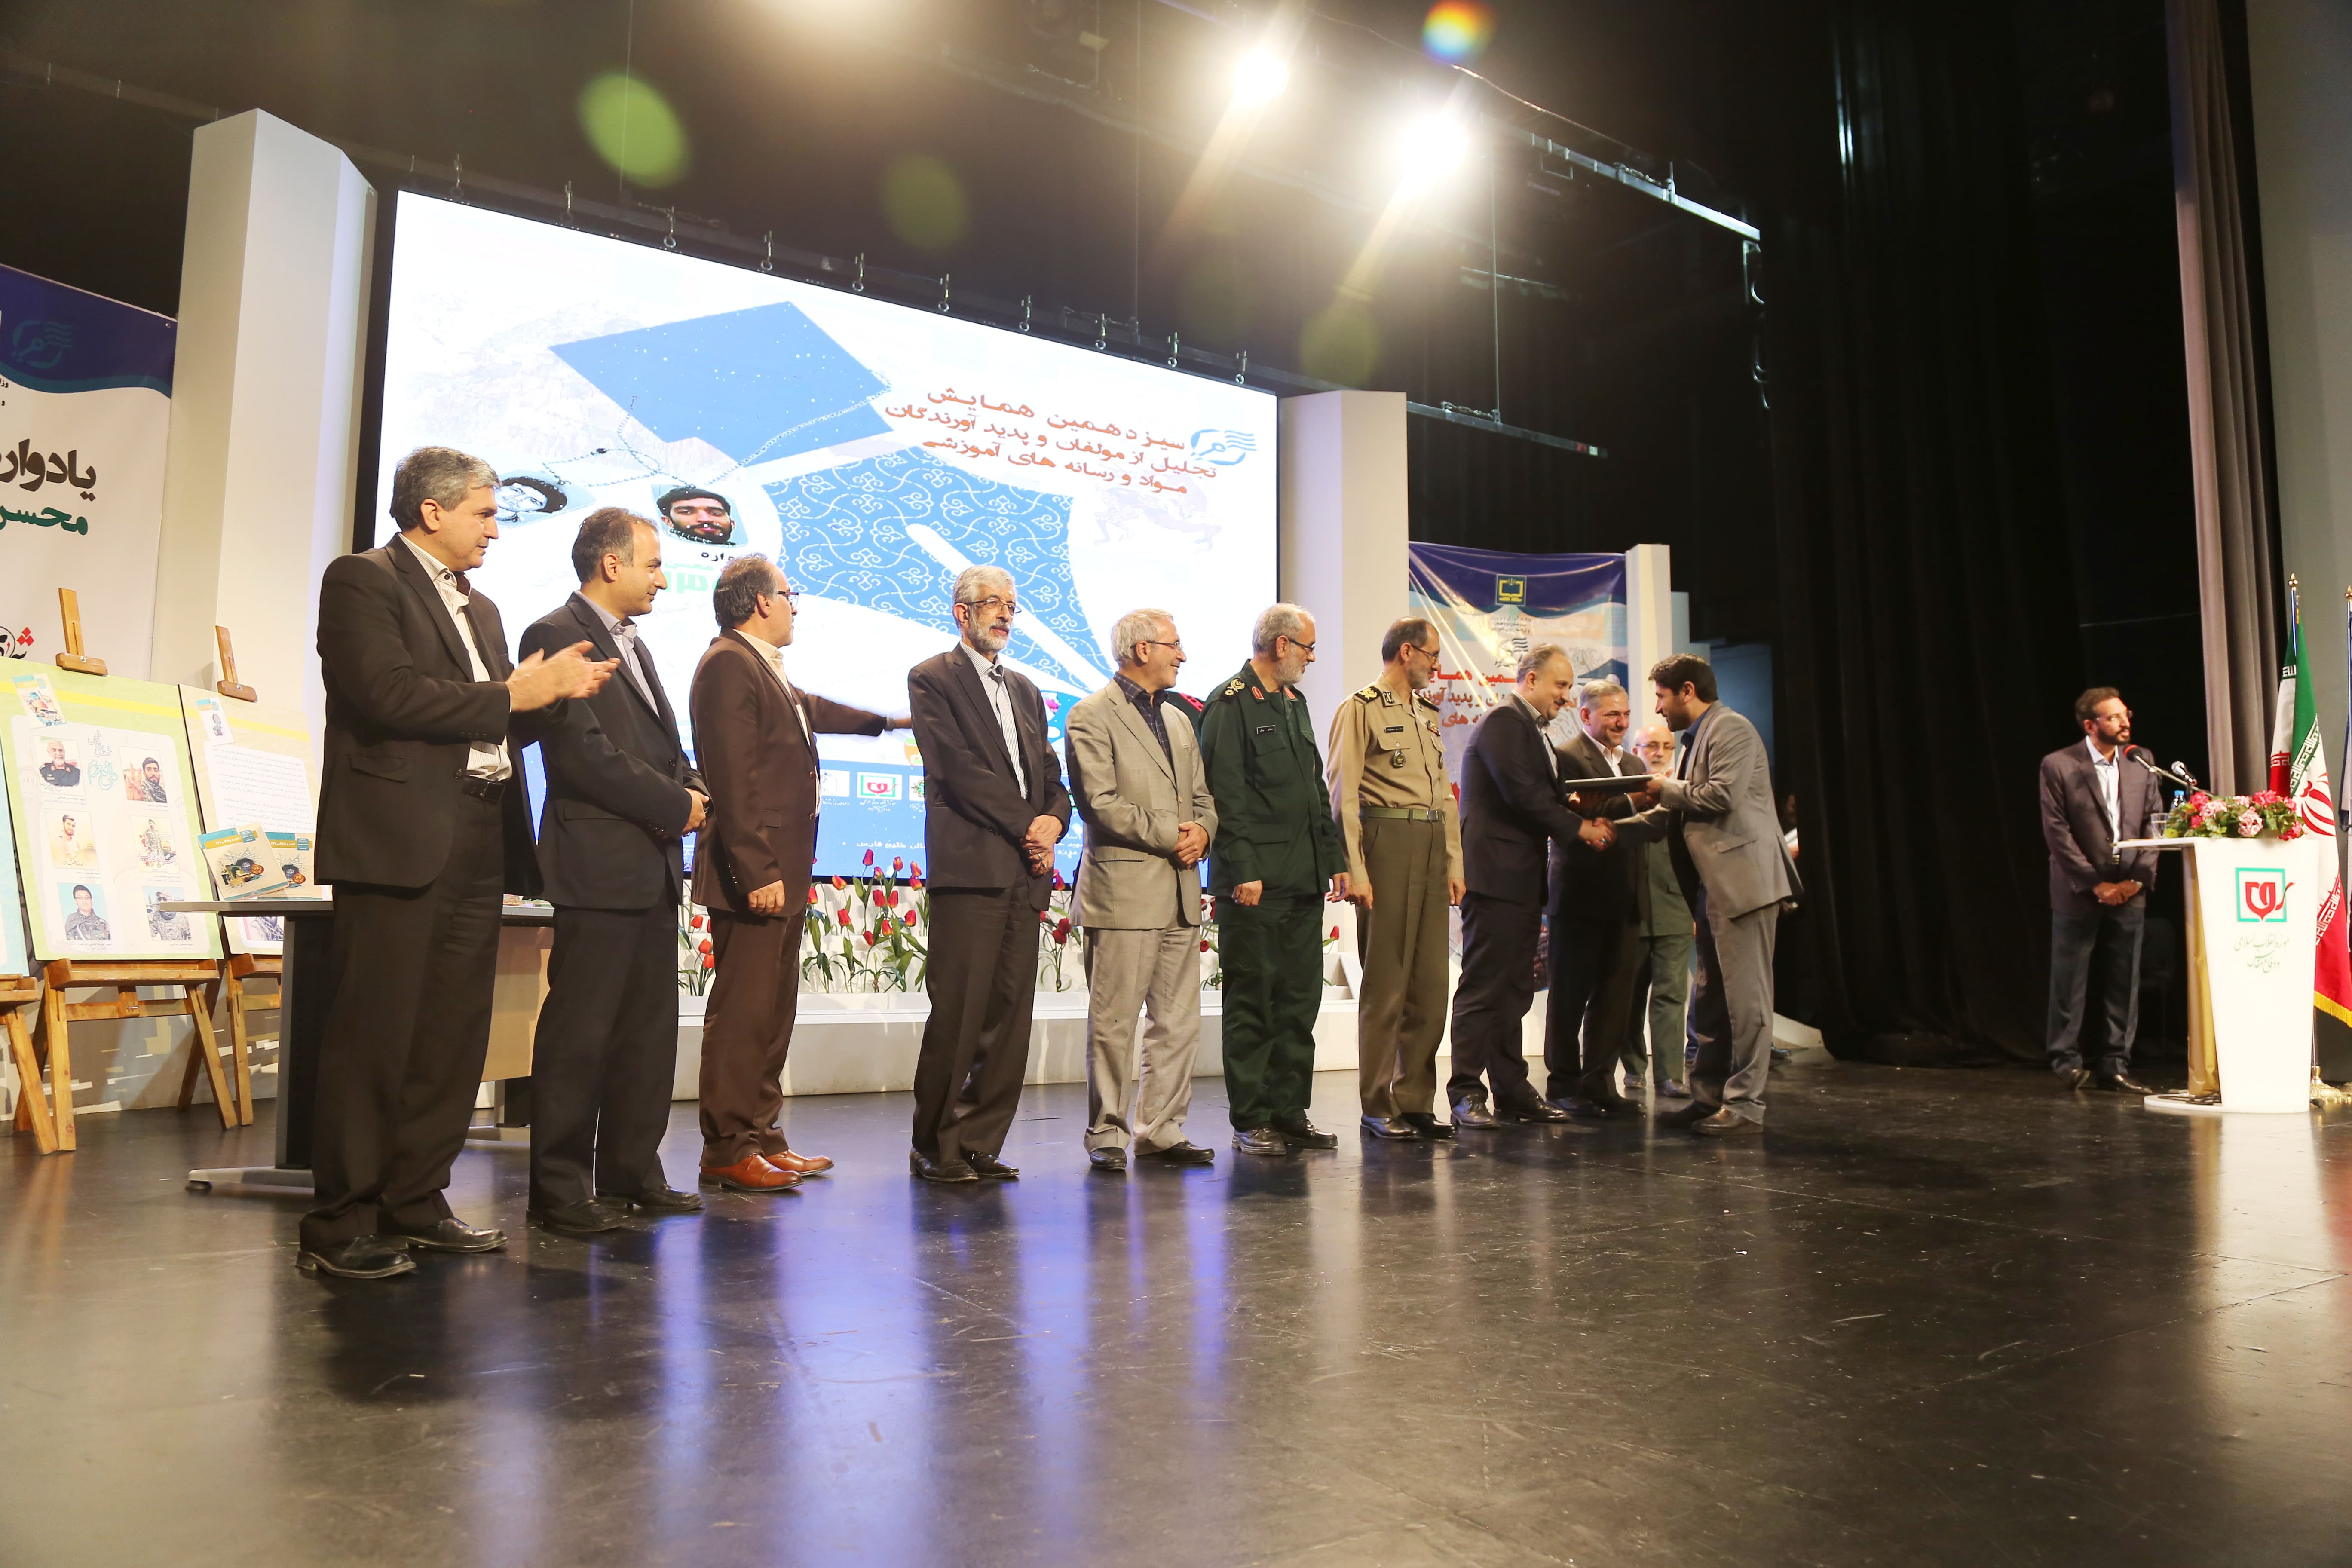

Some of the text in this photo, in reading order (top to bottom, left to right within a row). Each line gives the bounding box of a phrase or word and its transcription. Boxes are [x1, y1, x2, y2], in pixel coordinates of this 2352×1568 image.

[928, 388, 1034, 417] همایش
[885, 404, 1216, 479] تجلیل از مولفان و پدید آورندگان
[0, 438, 96, 502] یادوار
[923, 438, 1187, 493] مواد و رسانه های آموزشی
[1429, 664, 1473, 683] همای
[1448, 692, 1473, 708] پدید
[1442, 712, 1469, 727] های
